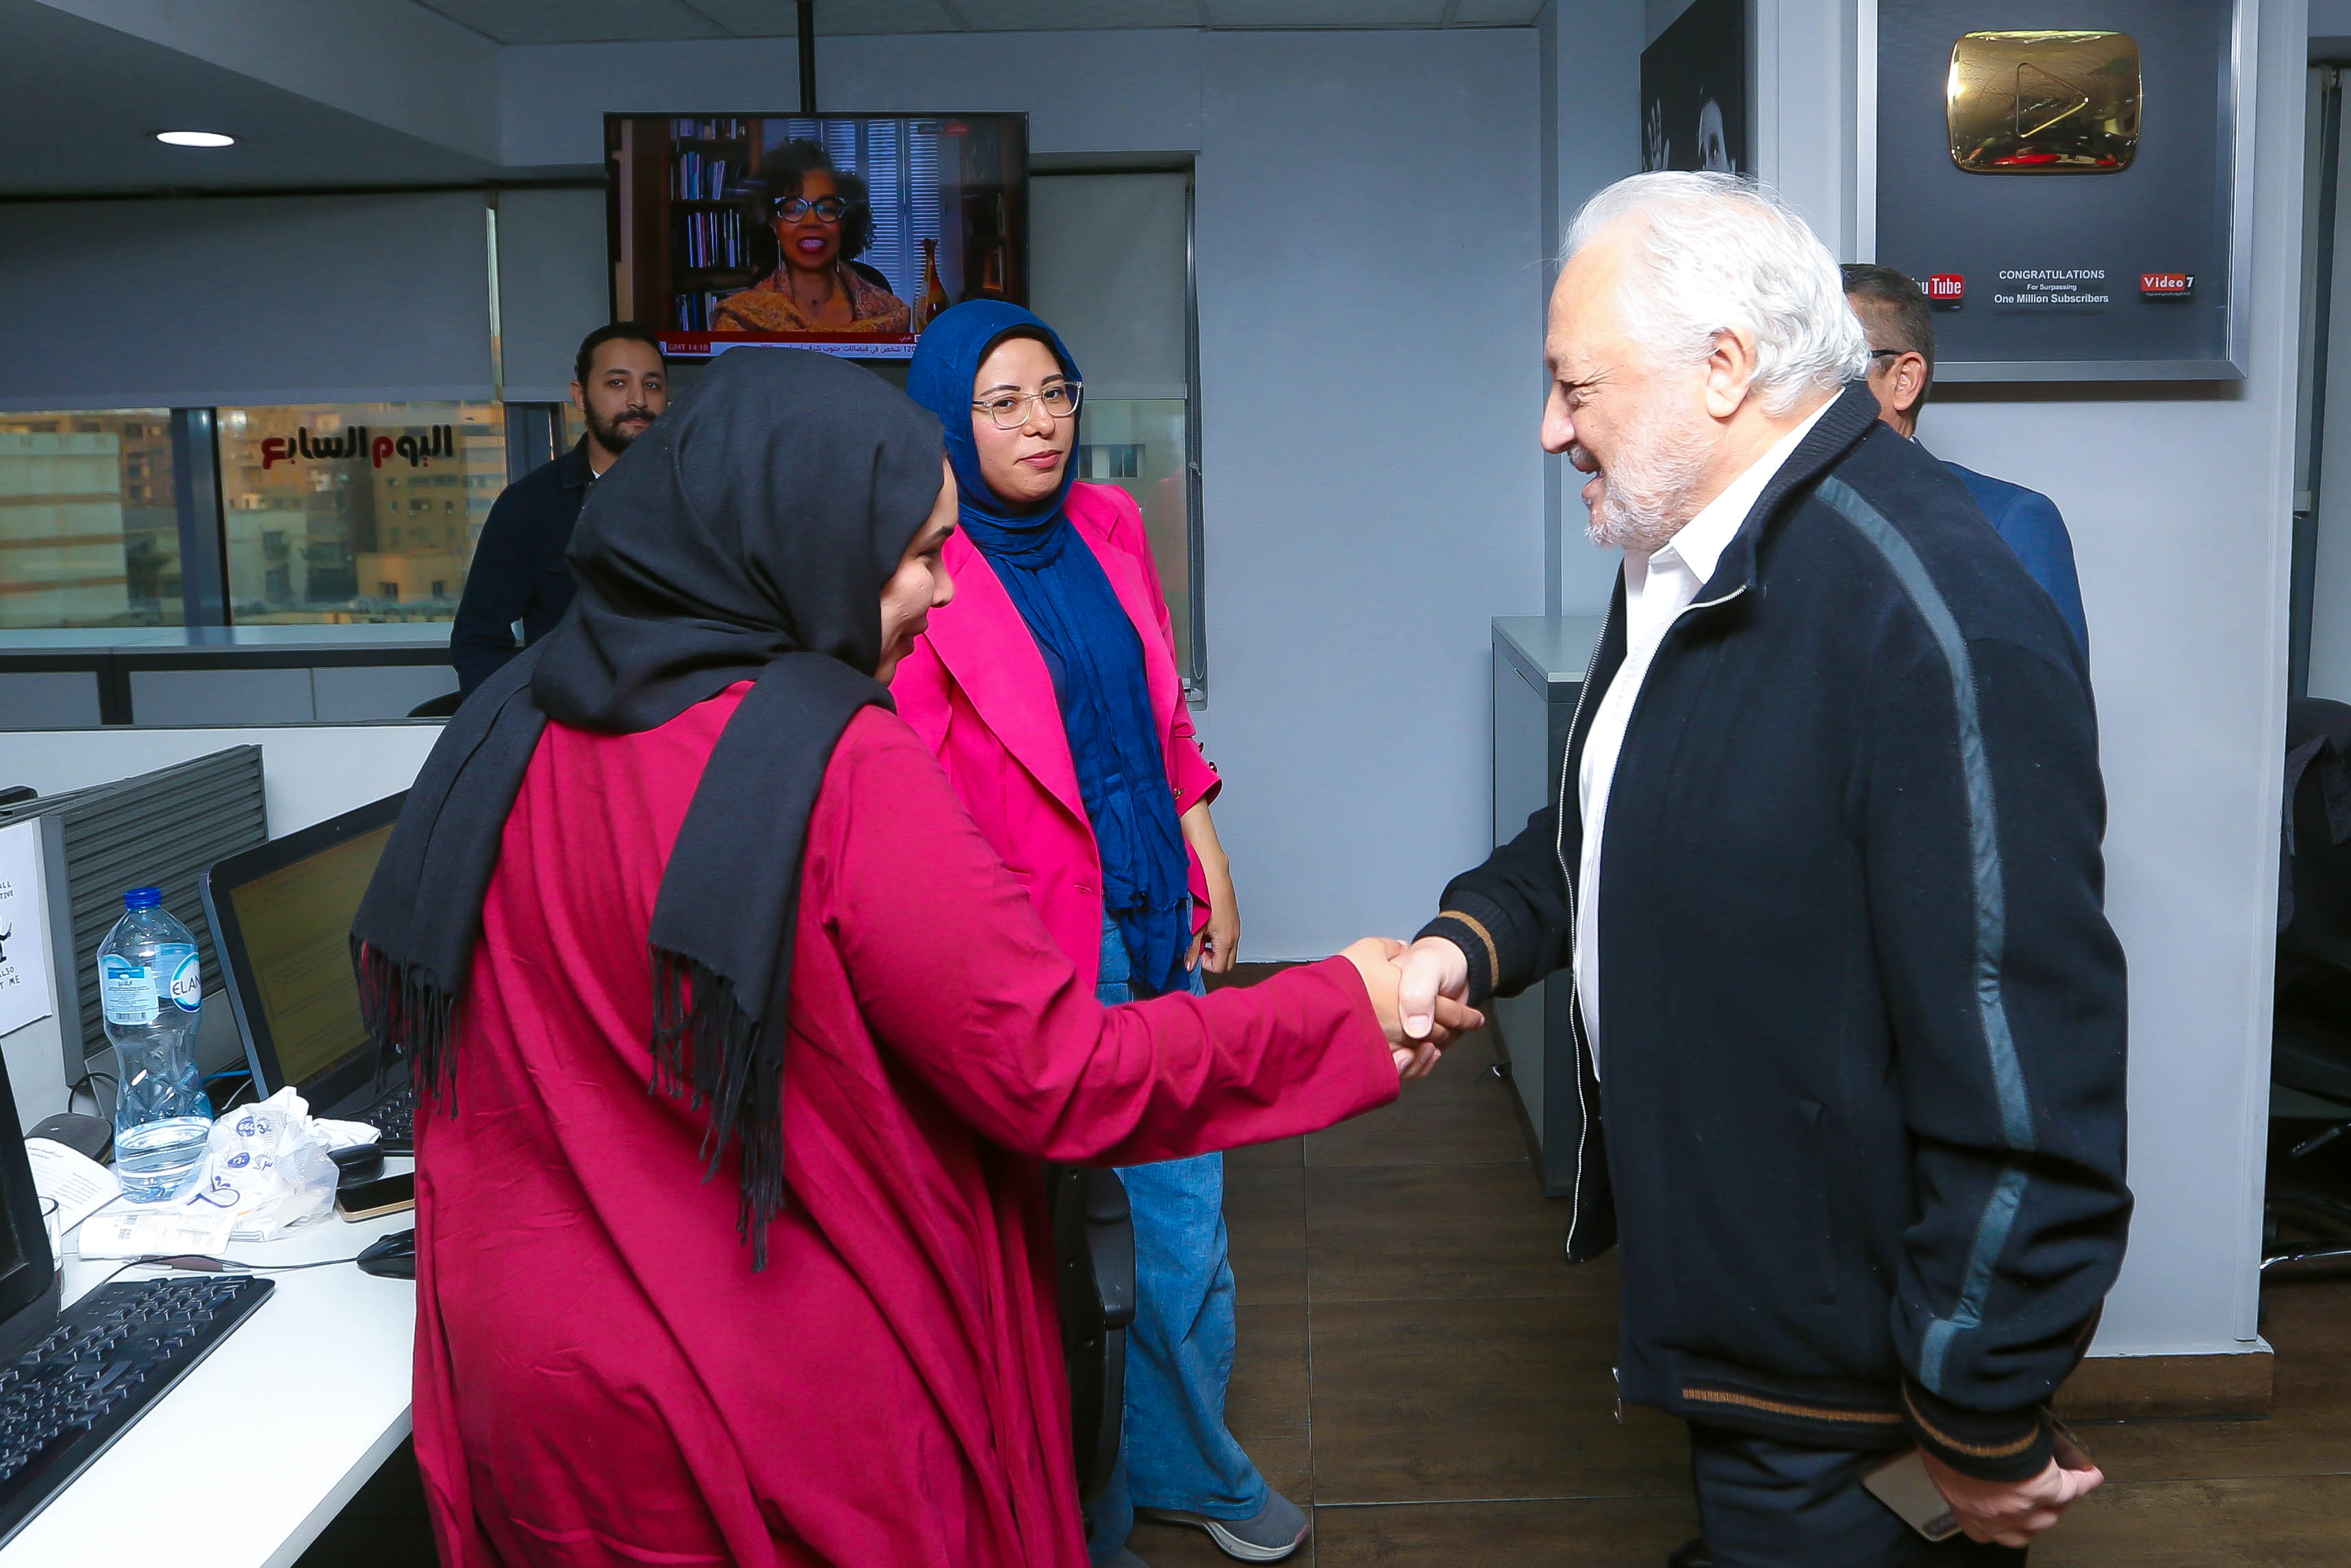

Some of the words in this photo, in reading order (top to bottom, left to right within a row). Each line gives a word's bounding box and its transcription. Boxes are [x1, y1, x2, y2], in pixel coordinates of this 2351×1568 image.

[1999, 270, 2105, 279] CONGRATULATIONS
[2144, 275, 2184, 287] Video
[2186, 277, 2194, 287] 7
[2039, 283, 2076, 292] Surpassing
[1994, 294, 2014, 303] One
[2016, 294, 2048, 303] Million
[2050, 294, 2109, 303] Subscribers
[260, 425, 368, 470] السابع
[371, 424, 453, 468] اليوم
[9, 975, 21, 986] ME
